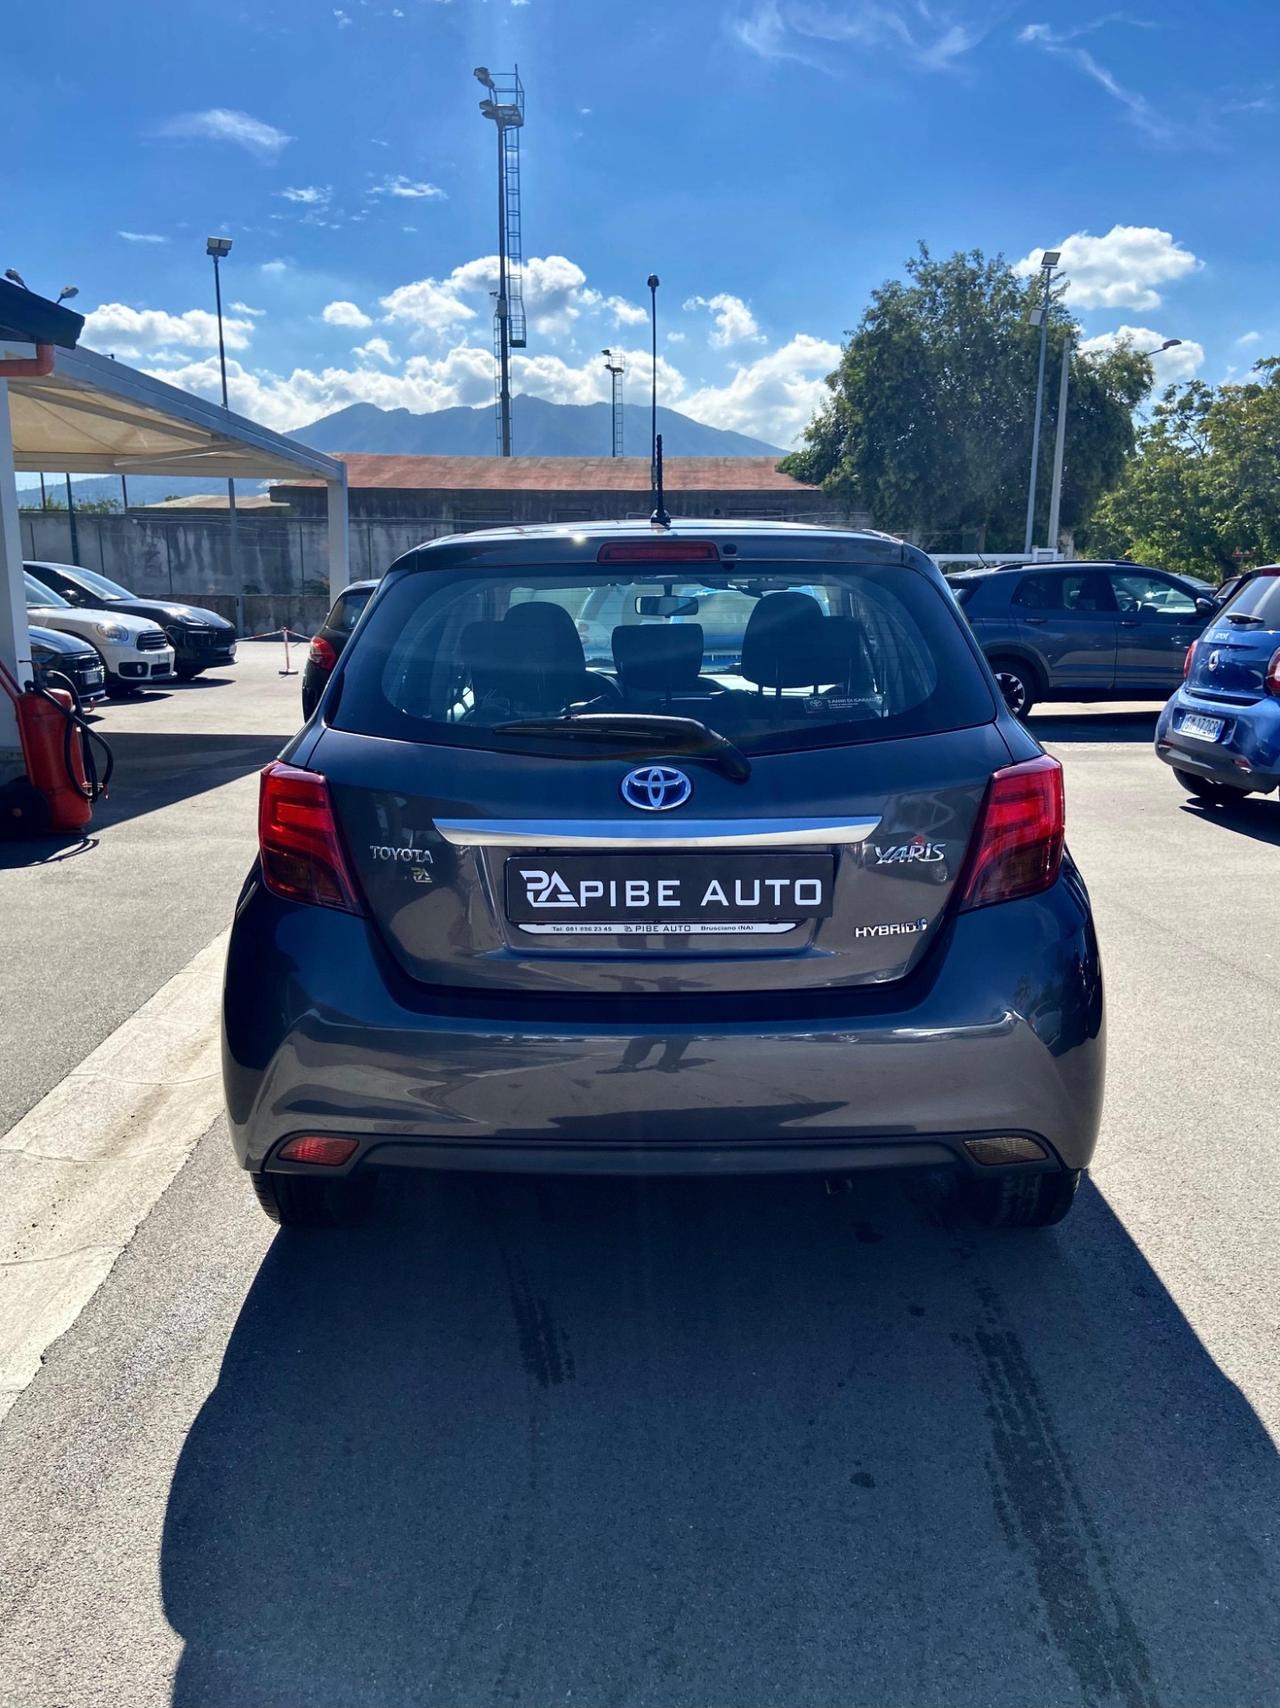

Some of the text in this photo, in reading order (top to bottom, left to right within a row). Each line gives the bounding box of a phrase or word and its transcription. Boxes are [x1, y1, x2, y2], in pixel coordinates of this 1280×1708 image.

[369, 845, 434, 864] TOYOTA
[874, 842, 946, 864] YARIS
[580, 879, 681, 907] PIBE
[700, 879, 822, 906] AUTO
[855, 924, 918, 938] HYBRID
